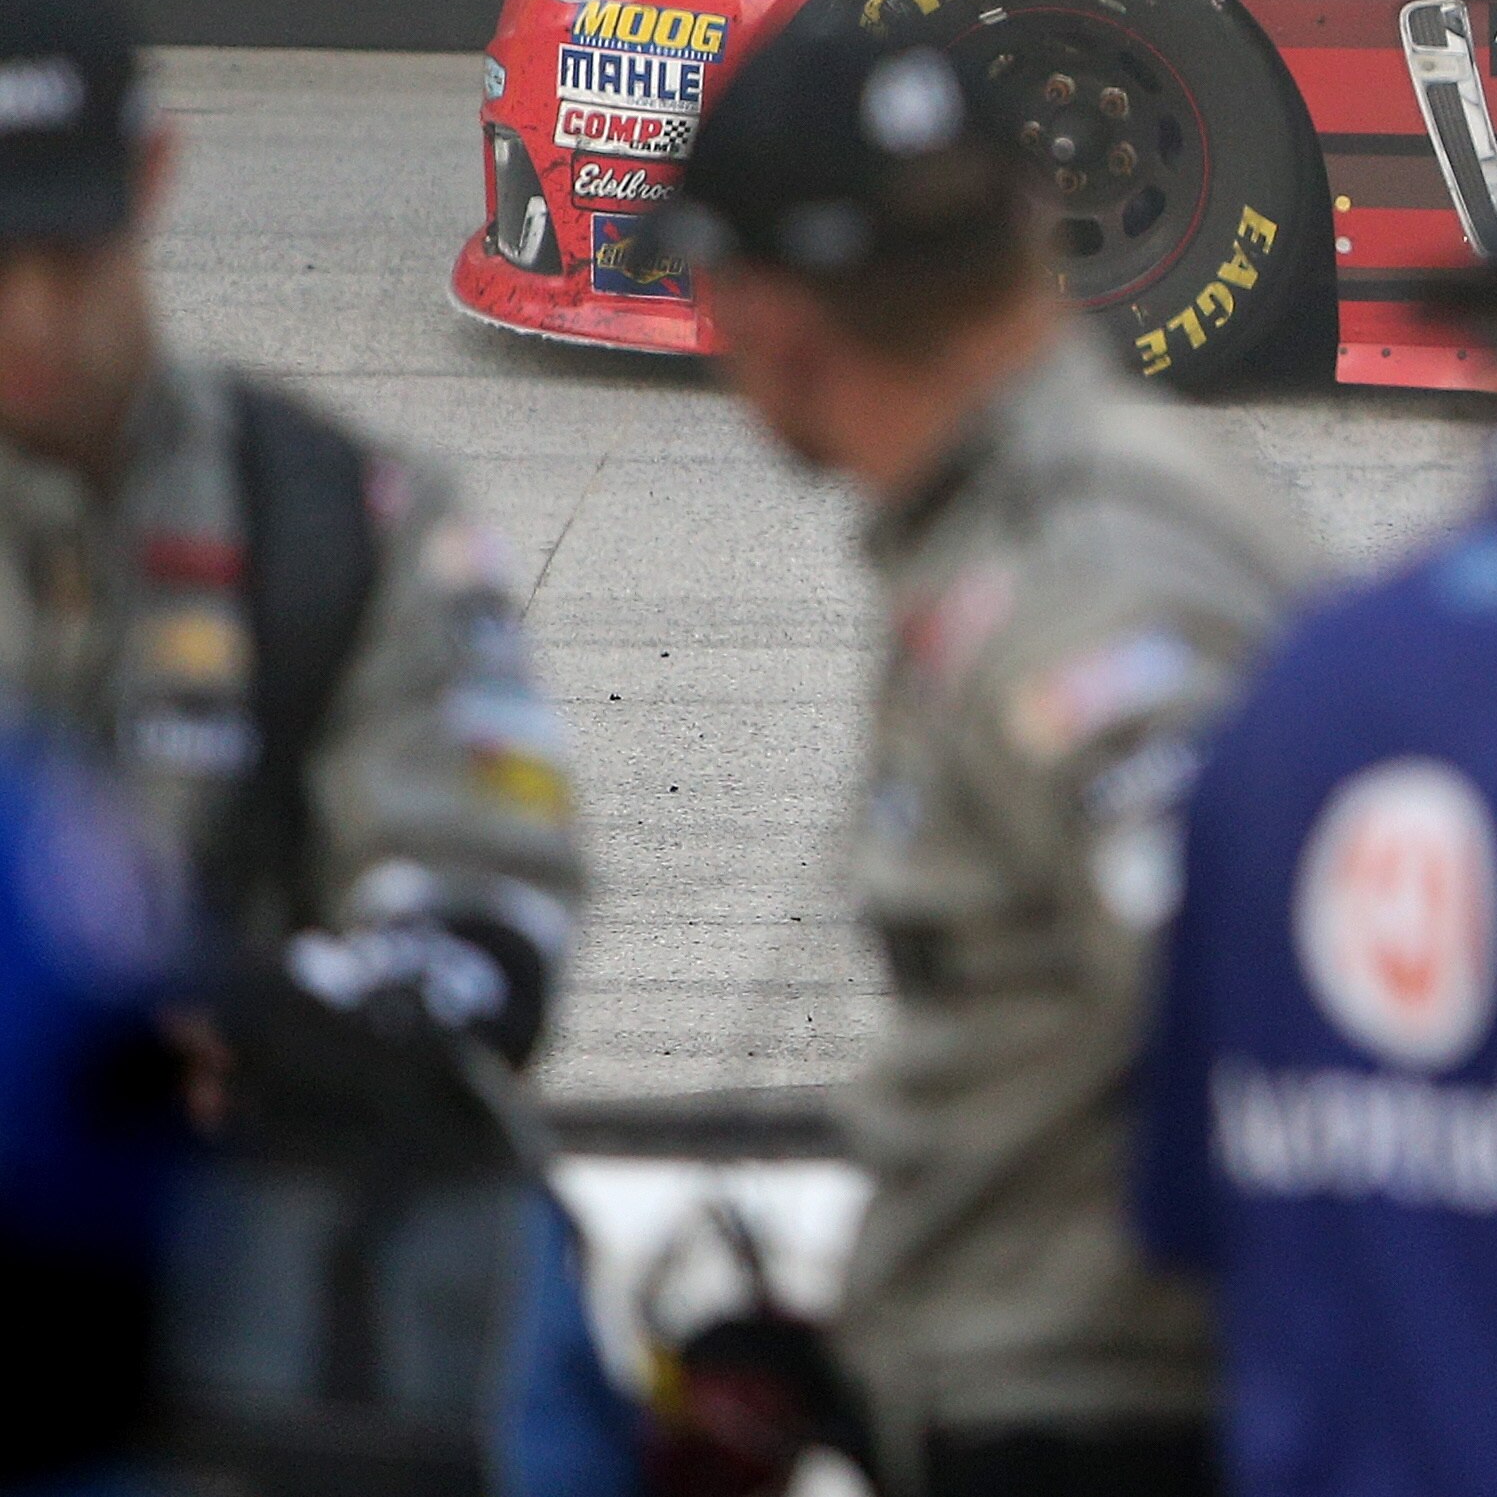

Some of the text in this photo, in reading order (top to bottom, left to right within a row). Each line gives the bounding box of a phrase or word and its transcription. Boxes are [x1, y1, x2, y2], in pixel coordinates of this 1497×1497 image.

[573, 0, 727, 53] MOOG
[560, 49, 702, 103] MAHLE
[563, 108, 663, 144] COMP
[574, 162, 684, 201] Edelbroc
[1134, 204, 1279, 378] EAGLE
